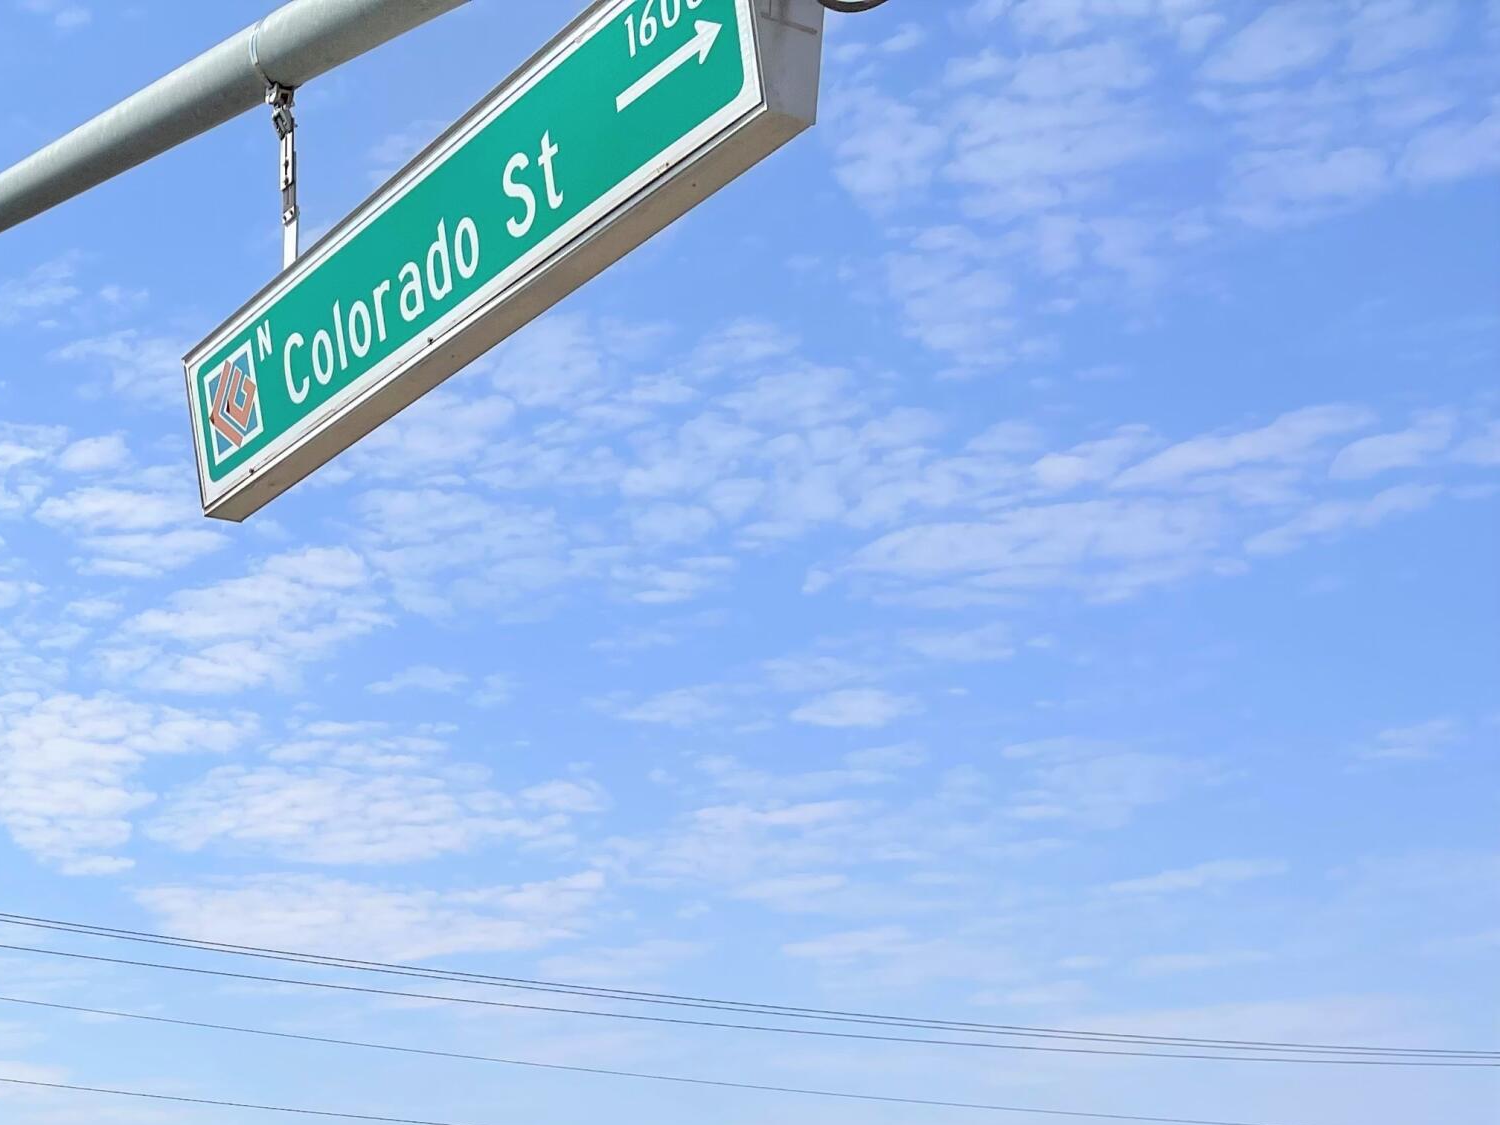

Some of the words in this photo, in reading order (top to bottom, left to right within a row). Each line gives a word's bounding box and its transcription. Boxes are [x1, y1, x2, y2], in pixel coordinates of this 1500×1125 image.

[624, 0, 706, 58] 160
[256, 320, 273, 362] N
[283, 217, 480, 405] Colorado
[501, 130, 565, 238] St
